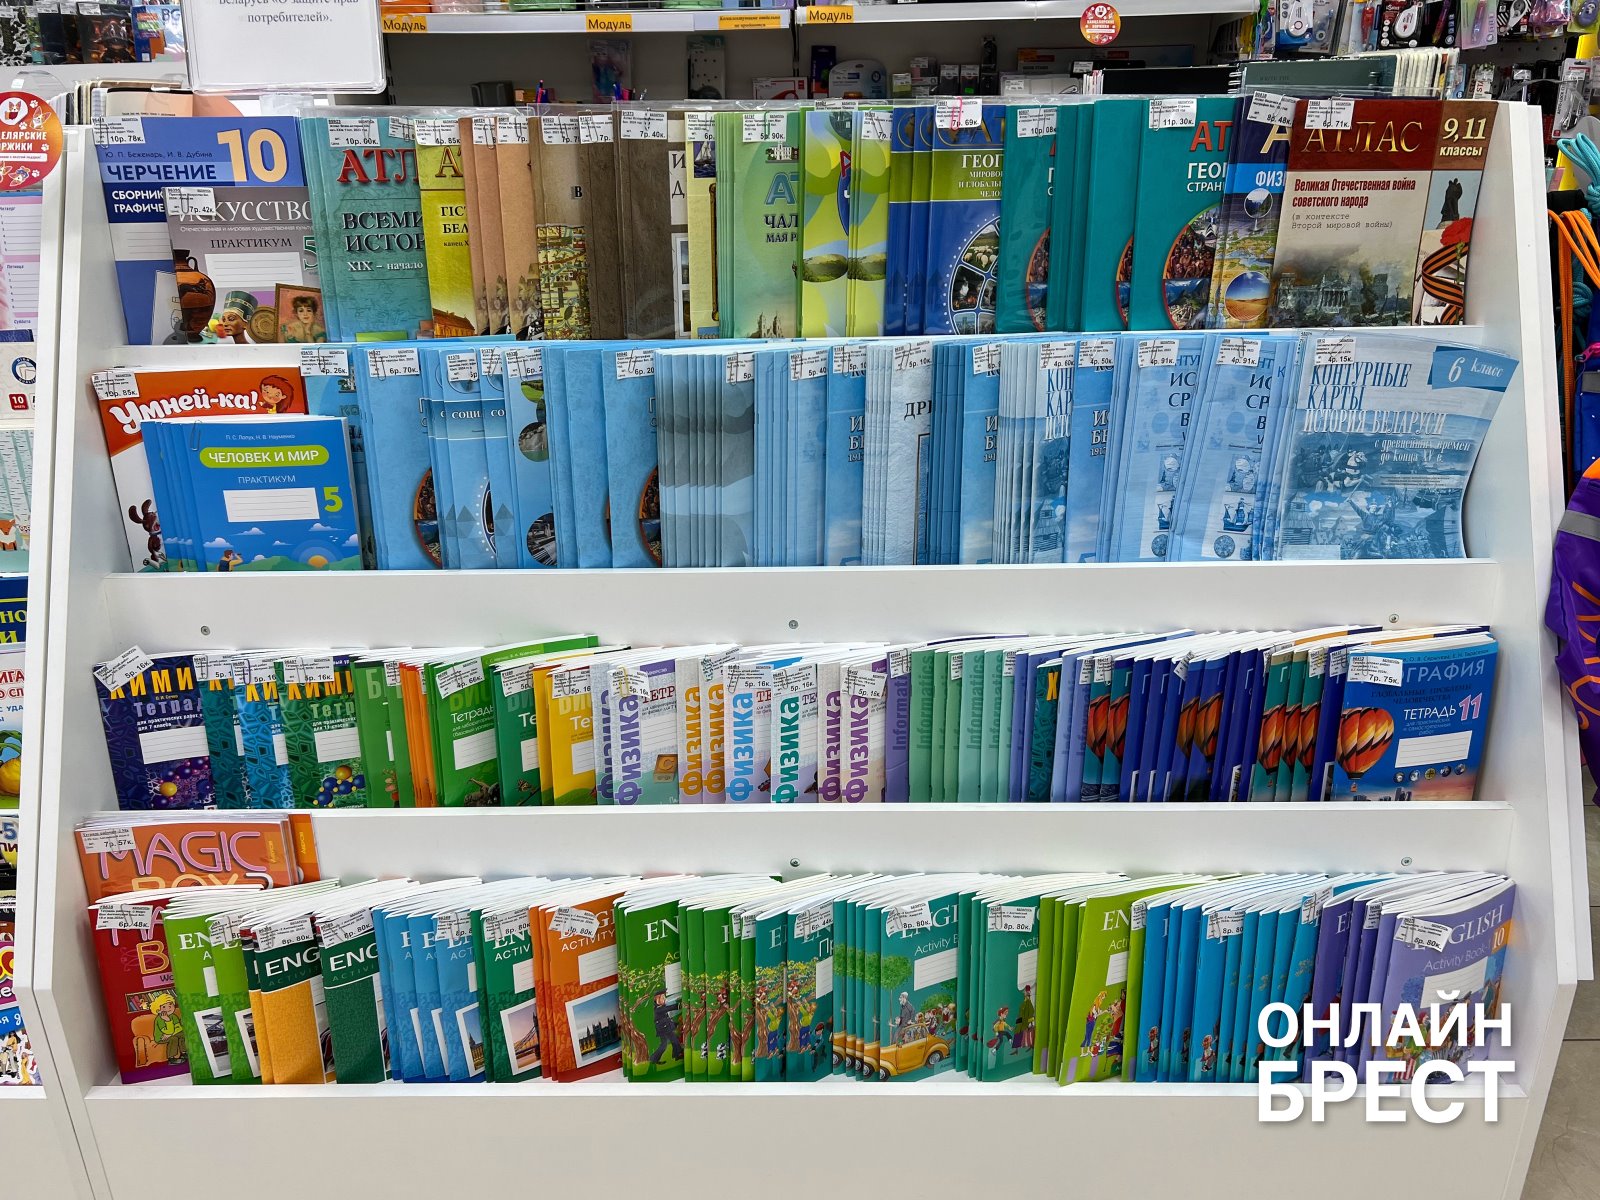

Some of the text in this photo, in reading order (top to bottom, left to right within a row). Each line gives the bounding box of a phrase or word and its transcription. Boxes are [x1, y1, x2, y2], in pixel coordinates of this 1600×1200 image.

[247, 11, 333, 25] потребителей».
[809, 10, 852, 22] Модуль
[383, 19, 426, 32] Модуль
[588, 18, 631, 31] Модуль
[964, 118, 979, 127] 69к.
[1163, 117, 1194, 127] 11р. 30к.
[1277, 116, 1292, 126] 48к.
[1334, 120, 1350, 129] 71к.
[1, 131, 47, 140] ЕЛЯРСКИЕ
[639, 130, 650, 139] 7р.
[771, 131, 785, 140] 90к.
[1442, 117, 1487, 143] 9,11
[110, 134, 144, 143] 10р. 78к.
[216, 128, 288, 183] 10
[1439, 145, 1482, 157] классы
[107, 164, 217, 181] ЧЕРЧЕНИЕ
[1294, 176, 1416, 192] Великая Отечественная война
[112, 189, 164, 200] СБОРНИК
[1292, 195, 1369, 209] советского народа
[114, 203, 165, 214] ГРАФИЧЕ
[201, 205, 215, 214] 42к.
[1305, 213, 1350, 221] контексте
[1291, 220, 1393, 230] Второй мировой войны)
[210, 238, 293, 249] ПРАКТИКУМ
[766, 233, 788, 243] МАЯ
[303, 235, 318, 270] 5
[386, 261, 424, 271] начало
[908, 360, 919, 369] 5р.
[1231, 357, 1257, 366] 4р. 91к.
[1338, 355, 1353, 364] 15к.
[333, 367, 348, 375] 26к.
[389, 366, 419, 375] 6р. 70к.
[808, 368, 818, 377] 5р.
[1311, 361, 1413, 388] КОНТУРНЫЕ
[1447, 356, 1504, 383] 6 класс
[121, 388, 138, 398] 85к.
[1306, 384, 1368, 410] КАРТЫ
[12, 396, 24, 404] 10
[109, 387, 259, 436] Умней-ка!
[1302, 408, 1448, 436] ИСТОРИЯ БЕЛАРУСИ
[209, 449, 320, 464] ЧЕЛОВЕК И МИР
[1380, 454, 1390, 465] до
[1392, 452, 1419, 463] конца
[238, 475, 296, 484] ПРАКТИКУМ
[323, 486, 344, 513] 5
[124, 660, 151, 679] 5р. 16к.
[1402, 658, 1486, 683] ГРАФИЯ
[317, 673, 333, 682] 16к.
[1369, 673, 1399, 685] 7р. 75к.
[744, 680, 756, 688] 5р.
[790, 685, 801, 693] 5р.
[858, 688, 869, 697] 5р.
[916, 655, 935, 750] Informatics
[1403, 692, 1483, 722] ТЕТРАДЬ 11
[725, 692, 754, 802] Физика
[771, 696, 800, 804] Физика
[117, 839, 134, 847] 57к.
[101, 830, 267, 880] MAGIC
[132, 920, 150, 929] 48к.
[903, 919, 932, 930] 8р. 80к.
[1003, 922, 1031, 931] 8р. 80к.
[1446, 903, 1505, 945] GLISH
[1222, 926, 1234, 936] 8р.
[295, 933, 313, 942] 80к.
[561, 928, 615, 953] ACTIVITY
[1492, 927, 1506, 949] 10
[914, 935, 951, 957] Activity
[1426, 938, 1442, 950] 80к.
[264, 946, 320, 977] ENG
[1423, 954, 1464, 972] Activity
